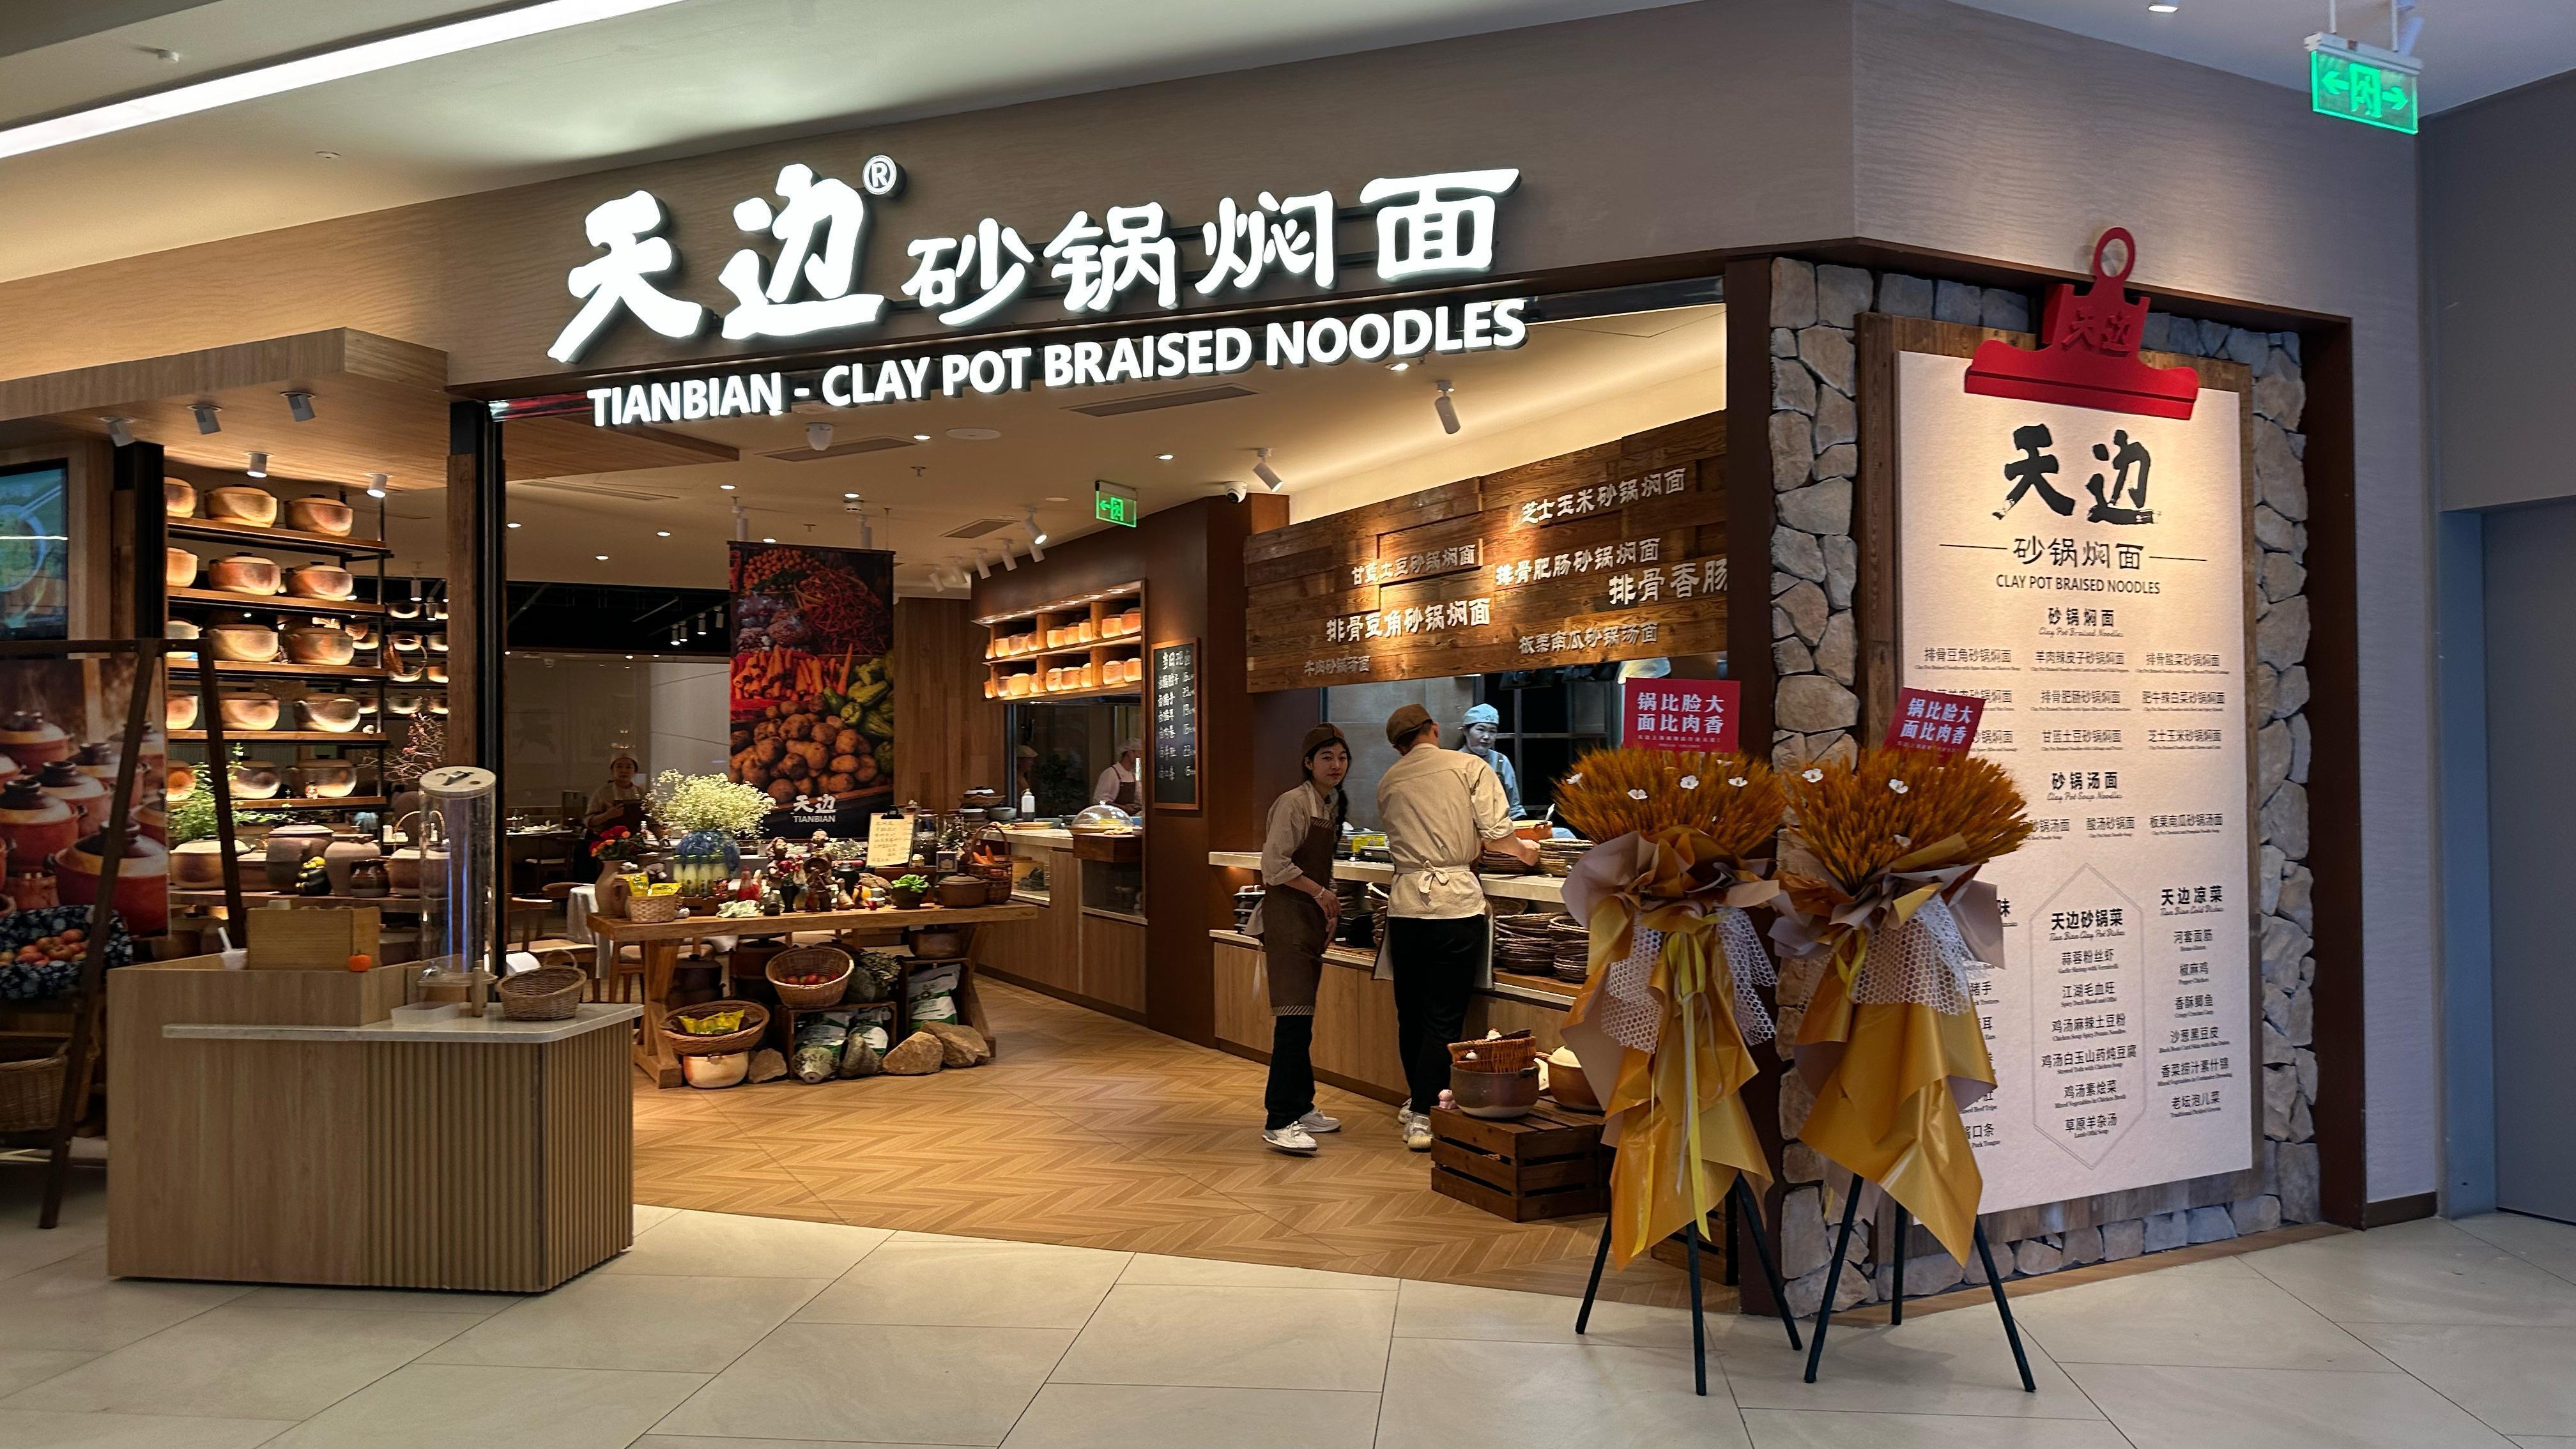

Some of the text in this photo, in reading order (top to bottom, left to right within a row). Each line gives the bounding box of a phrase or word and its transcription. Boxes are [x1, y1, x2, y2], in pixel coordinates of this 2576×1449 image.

[546, 162, 885, 364] 天边
[901, 168, 1520, 326] 砂锅焖面
[2060, 305, 2131, 357] 天边
[587, 371, 783, 427] TIANBIAN
[822, 356, 931, 407] CLAY
[942, 346, 1032, 397] POT
[1044, 327, 1253, 387] BRAISED
[1266, 298, 1526, 366] NOODLES
[1992, 423, 2162, 526] 天边
[1522, 468, 1687, 524] 芝士玉米砂锅焖面
[1496, 537, 1660, 586] 排骨肥肠砂锅焖面
[2012, 535, 2144, 571] 砂锅焖面
[1996, 574, 2161, 594] CLAY POT BRAISED NOODLES
[1326, 597, 1492, 643] 排骨豆角砂锅焖面
[2048, 607, 2115, 627] 砂锅焖面
[1637, 691, 1725, 714] 锅比脸大
[1906, 697, 1974, 724] 锅比脸大
[1637, 713, 1724, 735] 面比肉香
[1899, 719, 1968, 746] 面比肉香
[2051, 770, 2118, 790] 砂锅汤面
[790, 793, 838, 815] 天边
[2161, 885, 2223, 906] 天边凉菜
[2051, 908, 2124, 931] 天边砂锅菜
